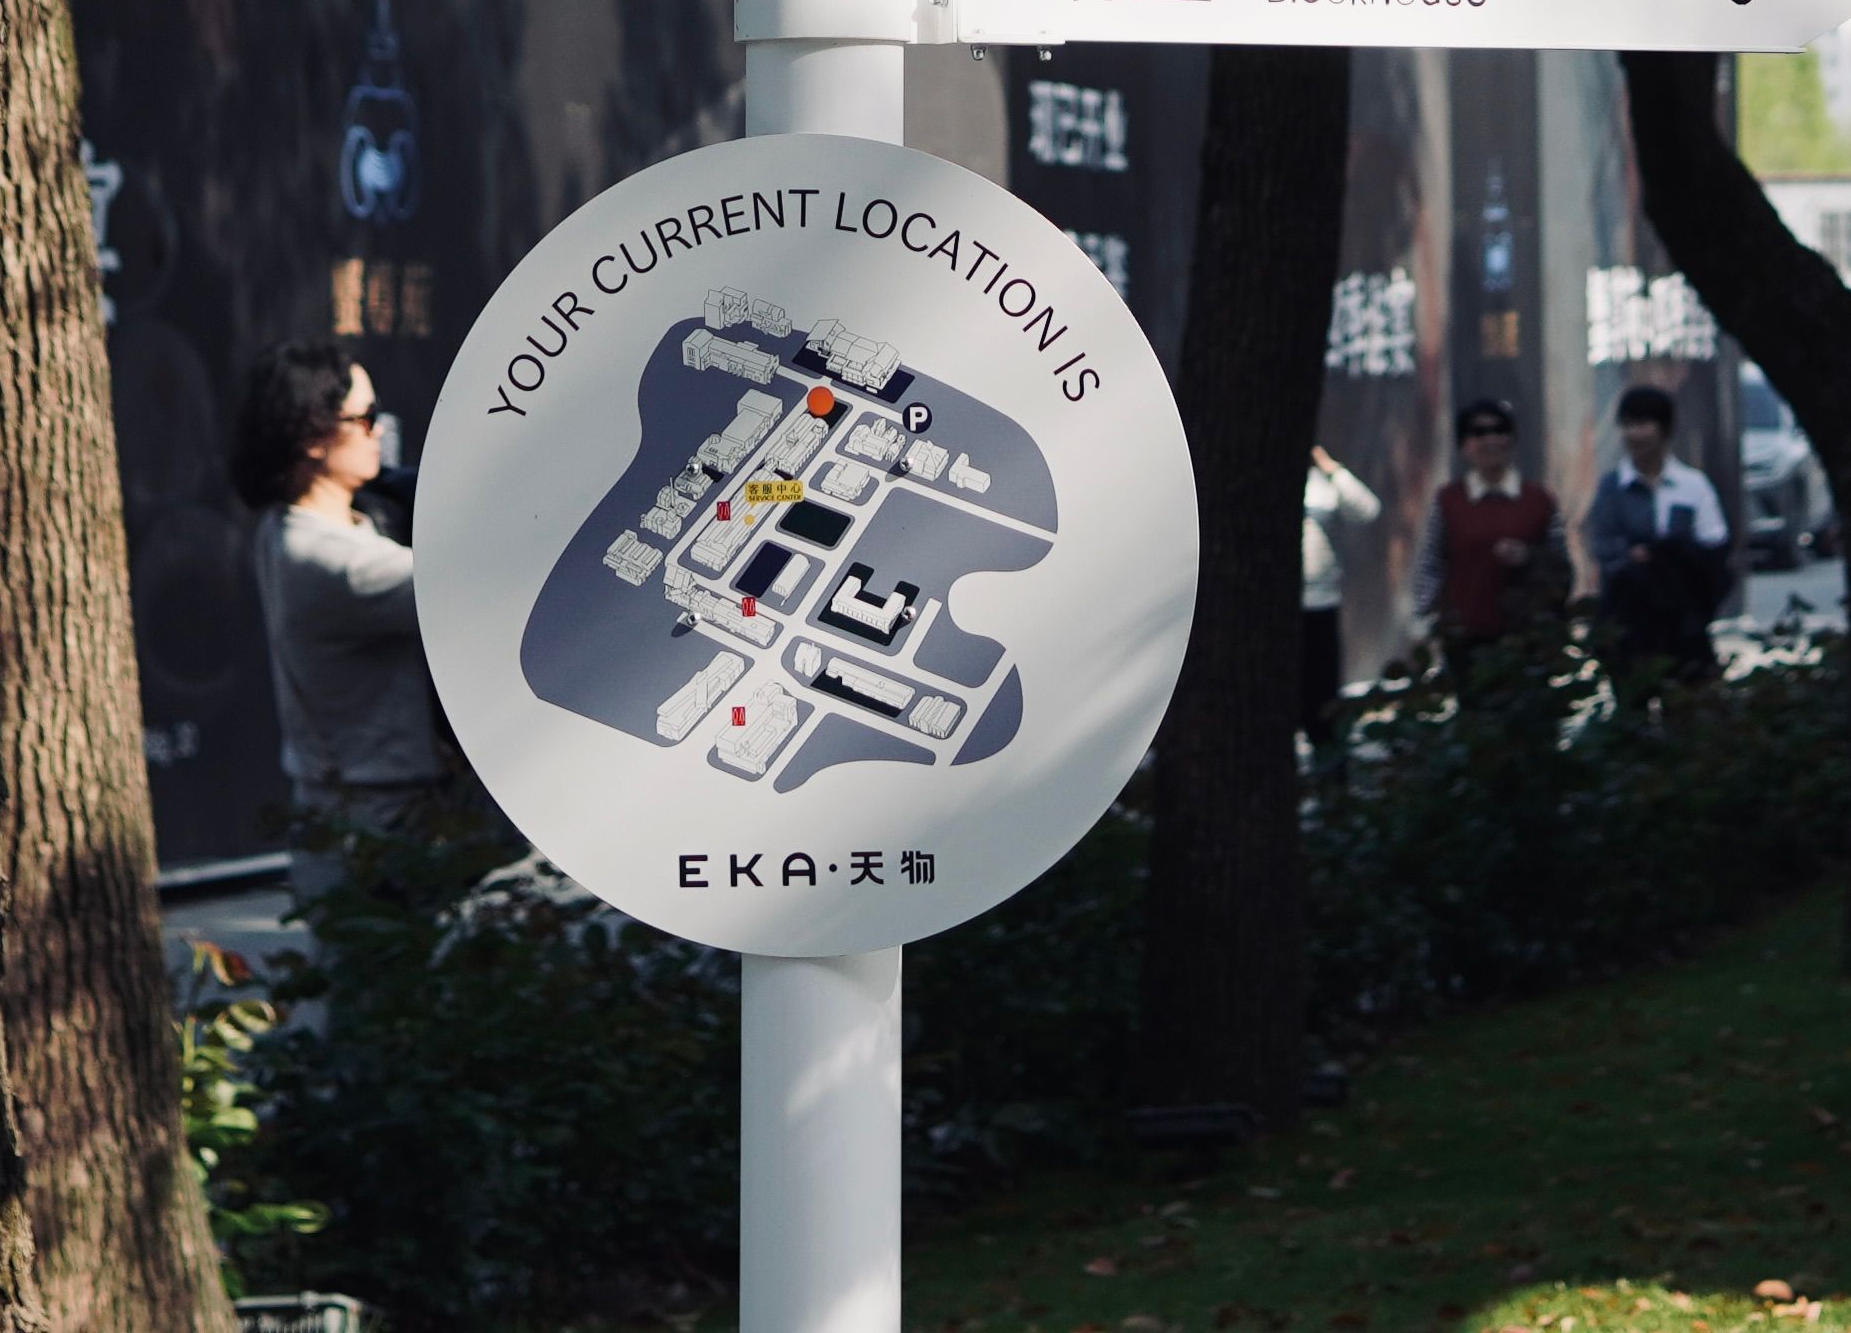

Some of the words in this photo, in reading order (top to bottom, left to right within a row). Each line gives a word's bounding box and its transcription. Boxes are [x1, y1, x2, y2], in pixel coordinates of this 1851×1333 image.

[487, 291, 595, 417] YOUR
[592, 189, 820, 295] CURRENT
[835, 192, 1068, 352] LOCATION
[1053, 352, 1101, 402] IS
[909, 406, 929, 432] P
[748, 482, 801, 494] 客服中心
